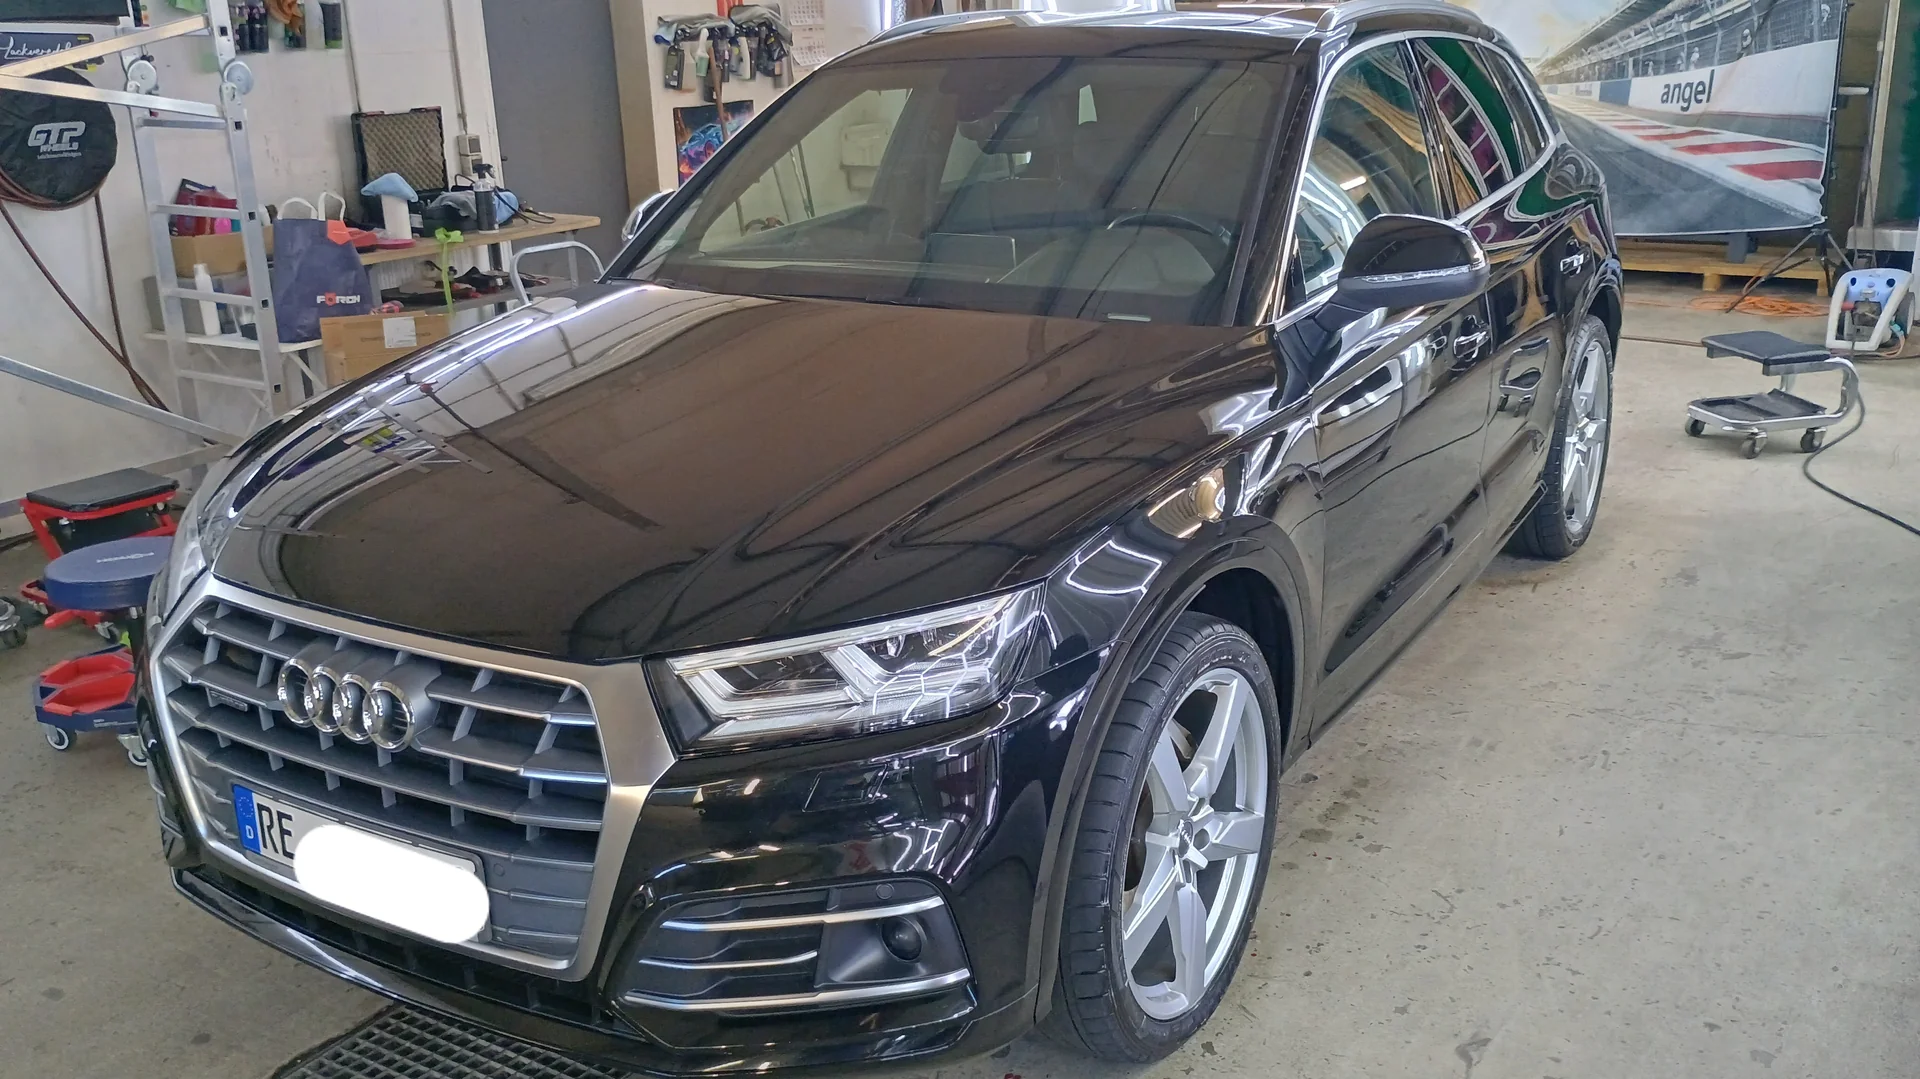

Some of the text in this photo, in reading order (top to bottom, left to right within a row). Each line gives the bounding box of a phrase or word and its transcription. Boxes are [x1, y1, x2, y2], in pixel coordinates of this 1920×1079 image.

[1661, 69, 1715, 112] angel
[28, 121, 86, 147] GTP
[245, 803, 294, 860] D RE
